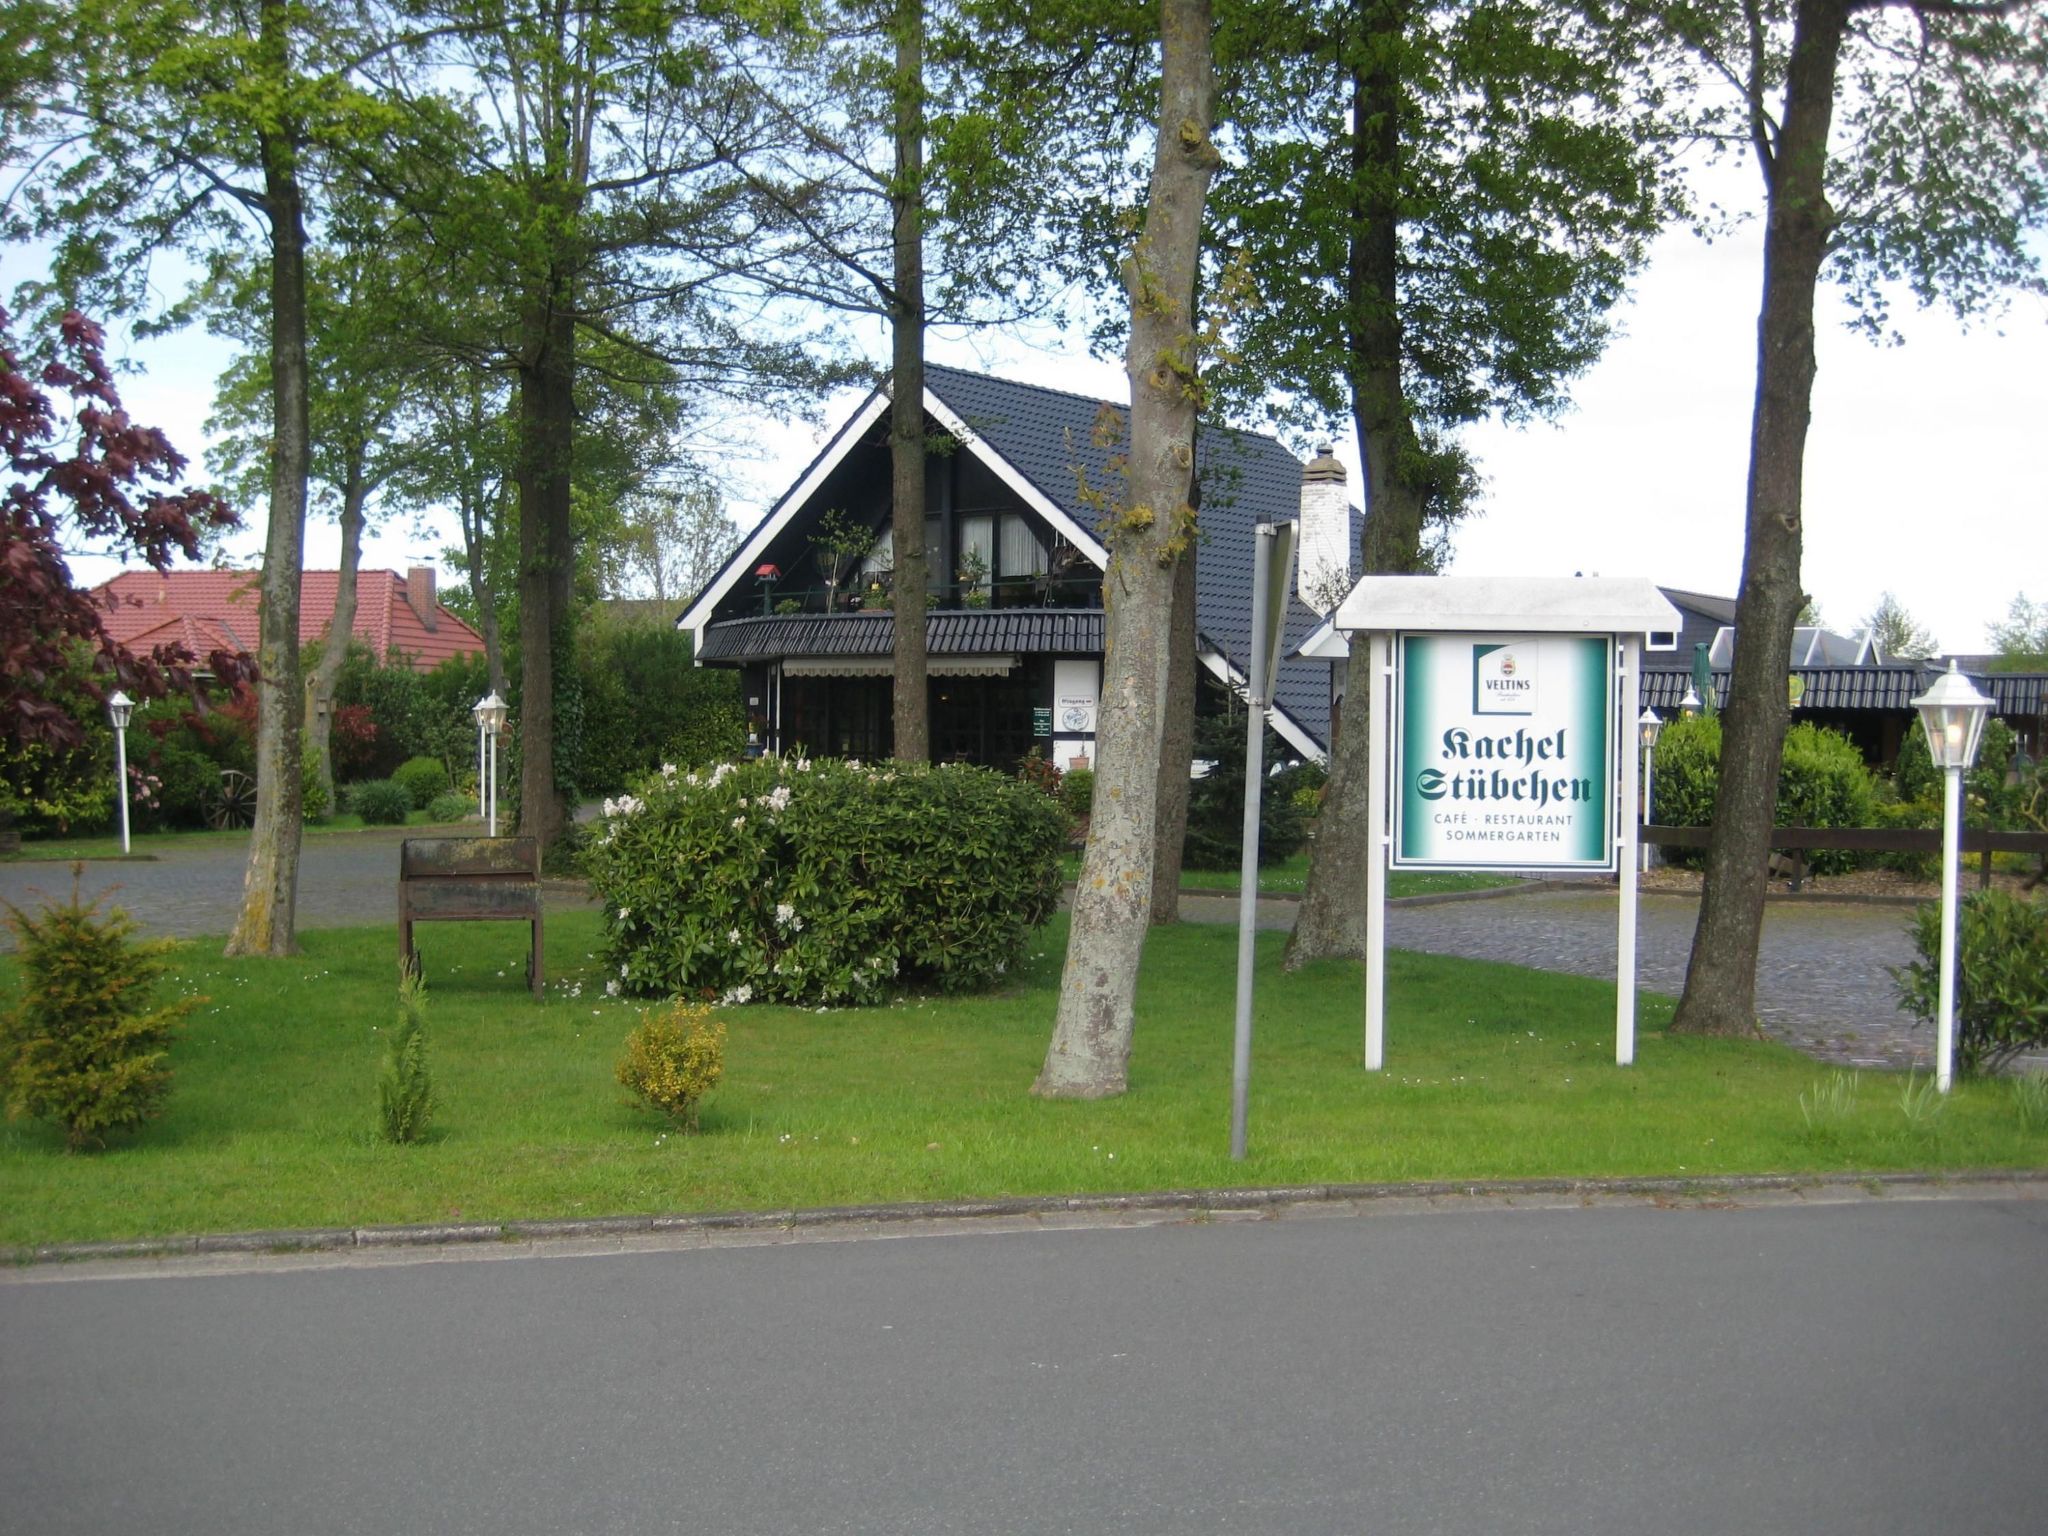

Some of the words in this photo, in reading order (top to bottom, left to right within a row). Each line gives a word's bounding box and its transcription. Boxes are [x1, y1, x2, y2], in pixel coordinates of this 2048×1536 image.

[1486, 679, 1531, 690] VELTINS
[1442, 727, 1567, 767] Kachel
[1416, 768, 1592, 810] Stübchen
[1434, 811, 1467, 825] CAFÉ
[1485, 814, 1573, 825] RESTAURANT
[1446, 830, 1560, 842] SOMMERGARTEN
